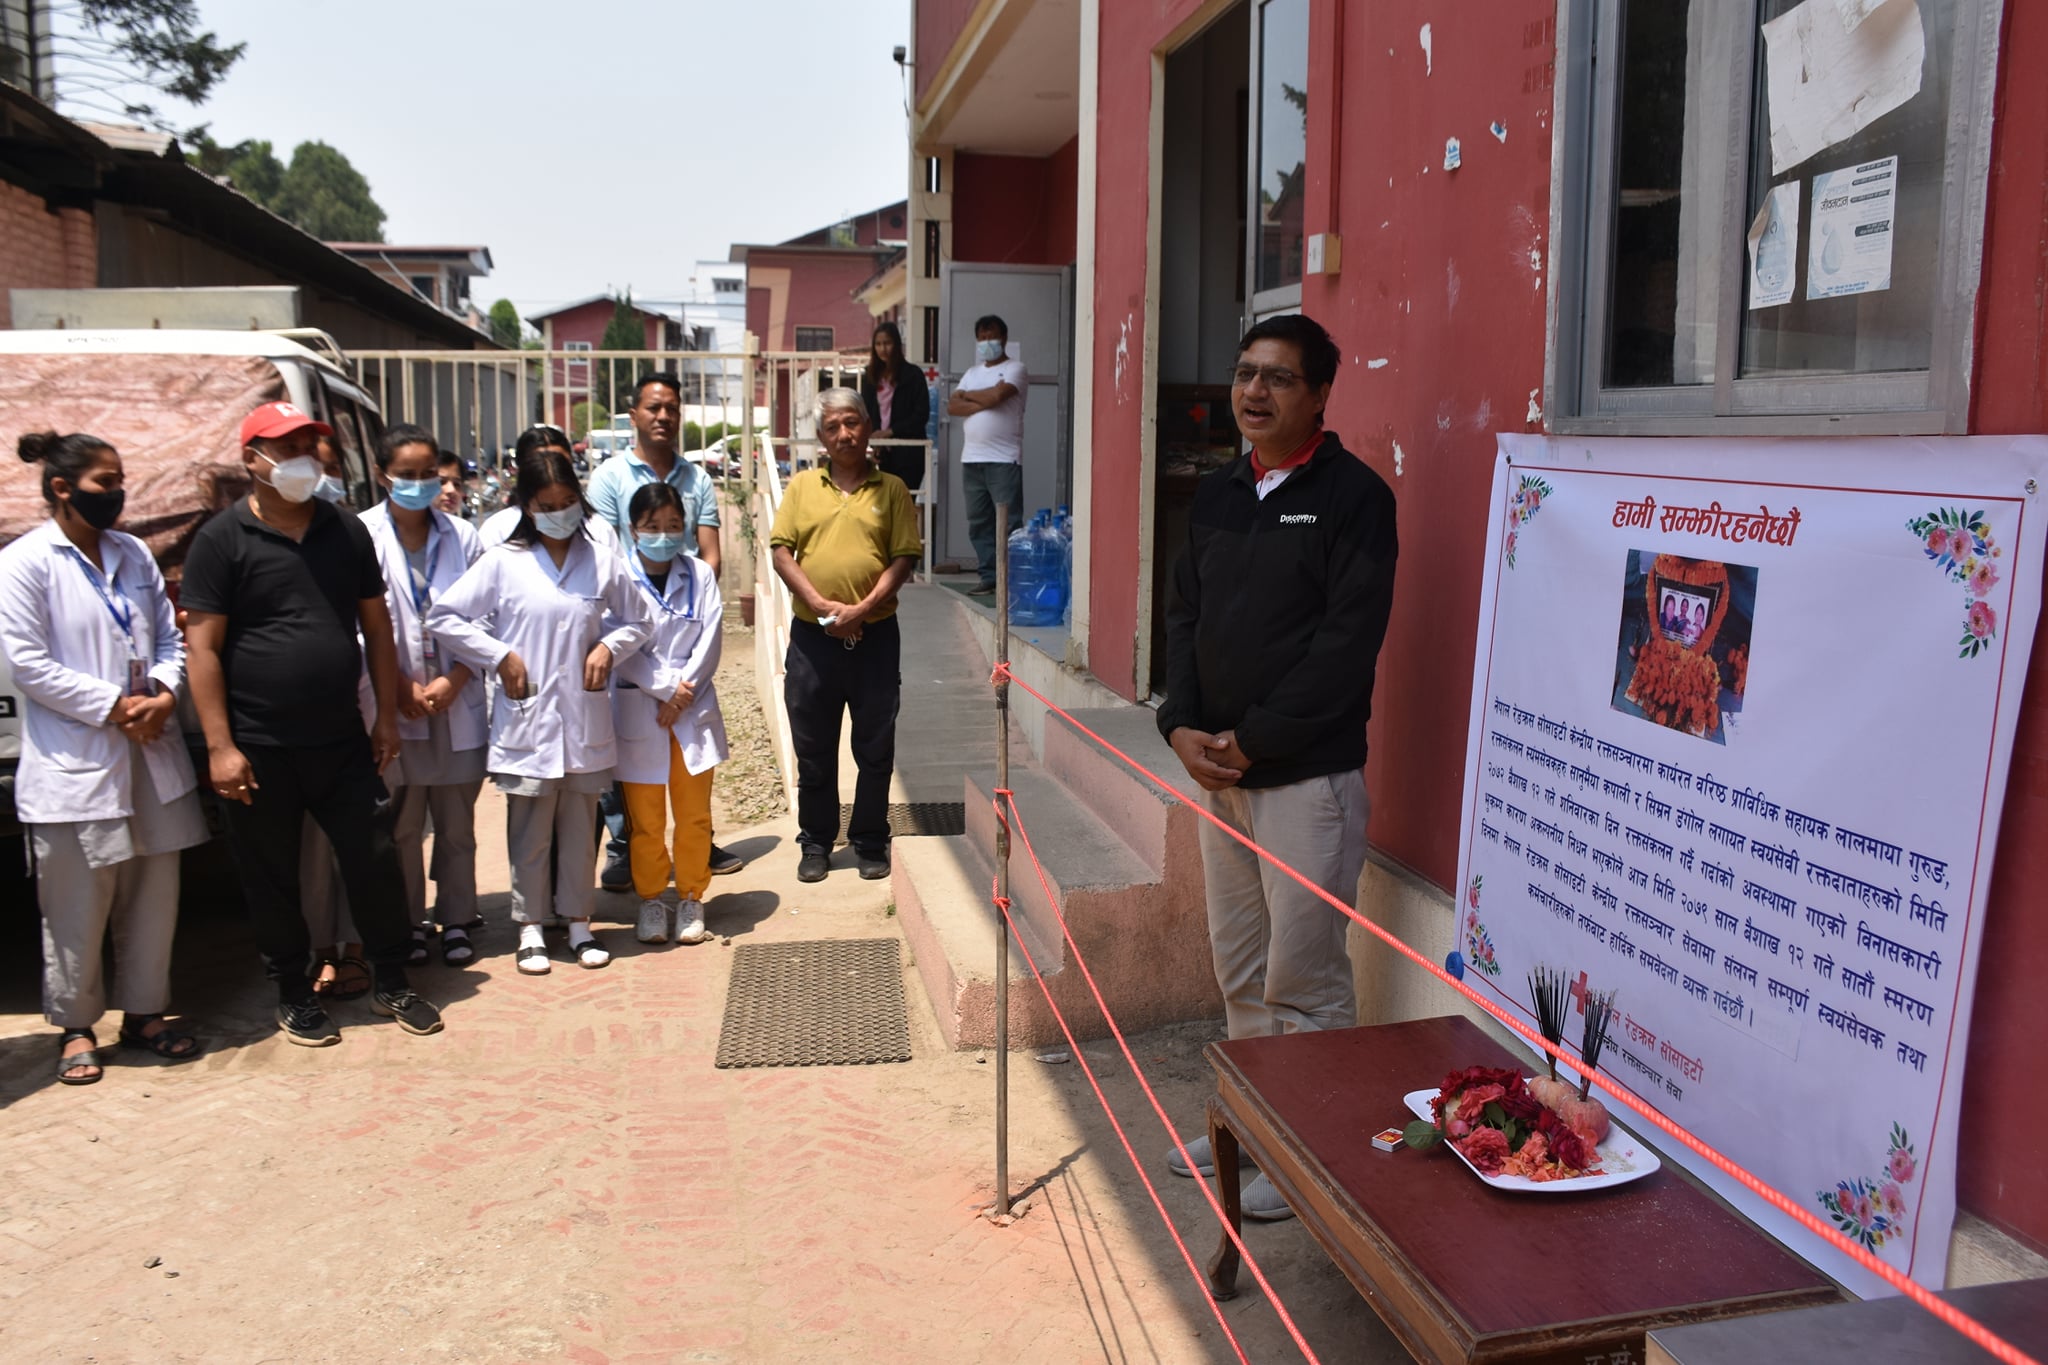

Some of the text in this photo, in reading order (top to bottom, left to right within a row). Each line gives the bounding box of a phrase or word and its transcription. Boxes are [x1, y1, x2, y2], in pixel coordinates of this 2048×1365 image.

[1612, 495, 1657, 529] हामी
[1488, 762, 1504, 783] २०७२
[1532, 783, 1540, 800] १२
[1545, 787, 1556, 806] गते
[1605, 811, 1620, 838] दिन
[1625, 826, 1674, 863] रक्तसंकलन
[1701, 860, 1735, 891] गर्दाको
[1742, 880, 1797, 919] अवस्थामा
[1806, 906, 1847, 940] गएको
[1857, 920, 1942, 980] विनासकारी
[1491, 731, 1524, 758] रक्तसंकलन
[1570, 764, 1600, 791] सानुमैया
[1603, 778, 1631, 804] कपाली
[1634, 792, 1642, 810] र
[1675, 808, 1705, 836] डंगोल
[1708, 822, 1746, 853] लगायत
[1751, 840, 1800, 876] स्वयंसेवी
[1806, 861, 1903, 915] रक्तदाताहरुको
[1909, 893, 1948, 933] मिति
[1494, 696, 1950, 890] नेपाल रेडक्रस सोसाइटी केन्द्रीय रक्तसञ्चारमा कार्यरत वरिष्ठ प्राविधिक सहायक लालमाया गुरुङ,
[1481, 818, 1927, 1074] दिनमा नेपाल रेडक्रस सोसाइटी केन्द्रीय रक्तसञ्चार सेवामा संलग्न सम्पूर्ण स्वयंसेवक तथा
[1506, 804, 1527, 826] कारण
[1530, 816, 1564, 846] अकल्पनीय
[1568, 830, 1588, 858] निधन
[1592, 848, 1624, 878] भएकोले
[1628, 866, 1648, 890] आज
[1653, 873, 1676, 904] मिति
[1682, 892, 1707, 924] २०७९
[1715, 909, 1739, 936] साल
[1788, 944, 1804, 969] १२
[1813, 953, 1835, 980] गते
[1884, 986, 1935, 1027] स्मरण
[1610, 931, 1636, 959] हार्दिक
[1682, 974, 1709, 1002] व्यक्त
[1625, 1014, 1656, 1052] रेडक्रस
[1660, 1040, 1704, 1084] सोसाइटी
[1666, 1078, 1683, 1102] सेवा
